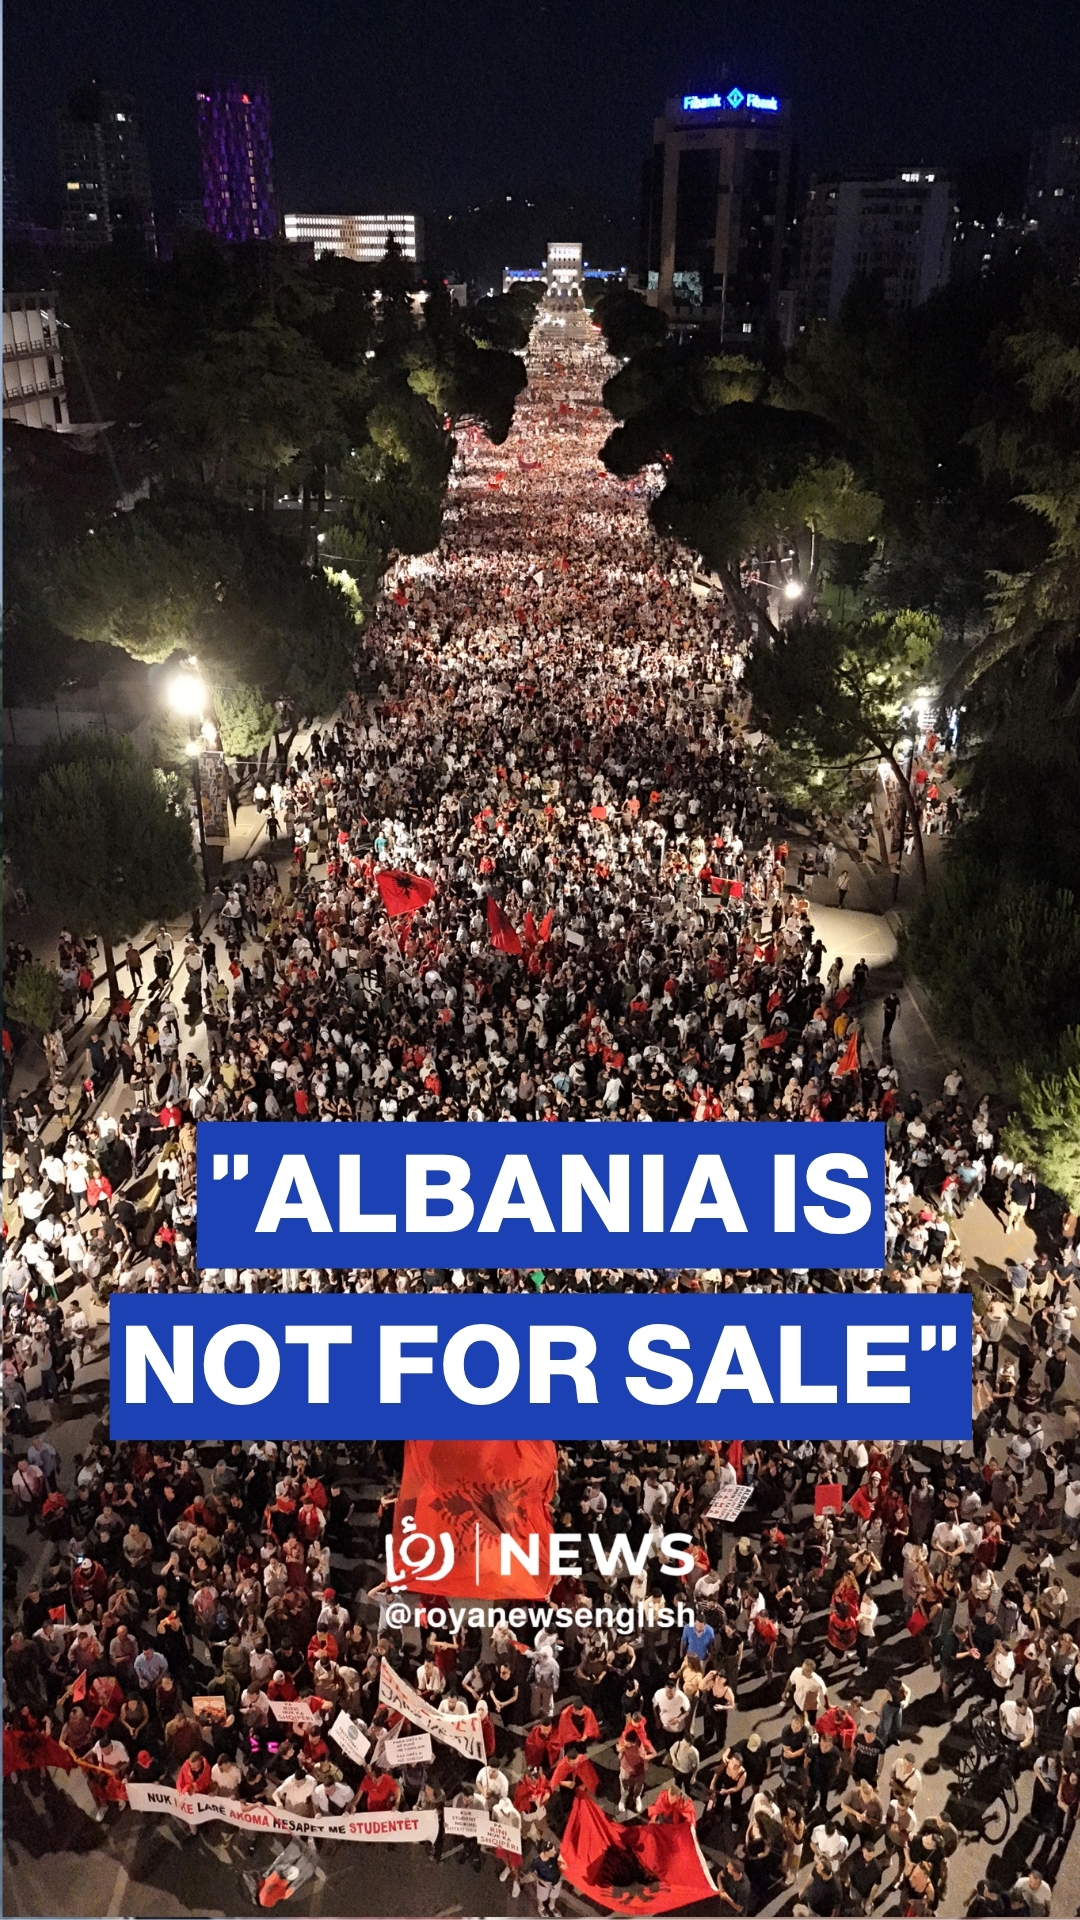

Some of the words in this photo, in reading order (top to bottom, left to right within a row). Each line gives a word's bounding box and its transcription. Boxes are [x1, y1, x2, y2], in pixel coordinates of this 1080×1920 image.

[683, 94, 722, 110] Fibank
[746, 94, 778, 111] Fibank
[147, 1792, 172, 1805] NUK
[197, 1802, 226, 1816] LARË
[229, 1809, 270, 1827] AKOMA
[273, 1817, 325, 1833] HESAPET
[328, 1825, 346, 1834] ME
[349, 1816, 419, 1834] STUDENTËT
[489, 1827, 508, 1836] RINI
